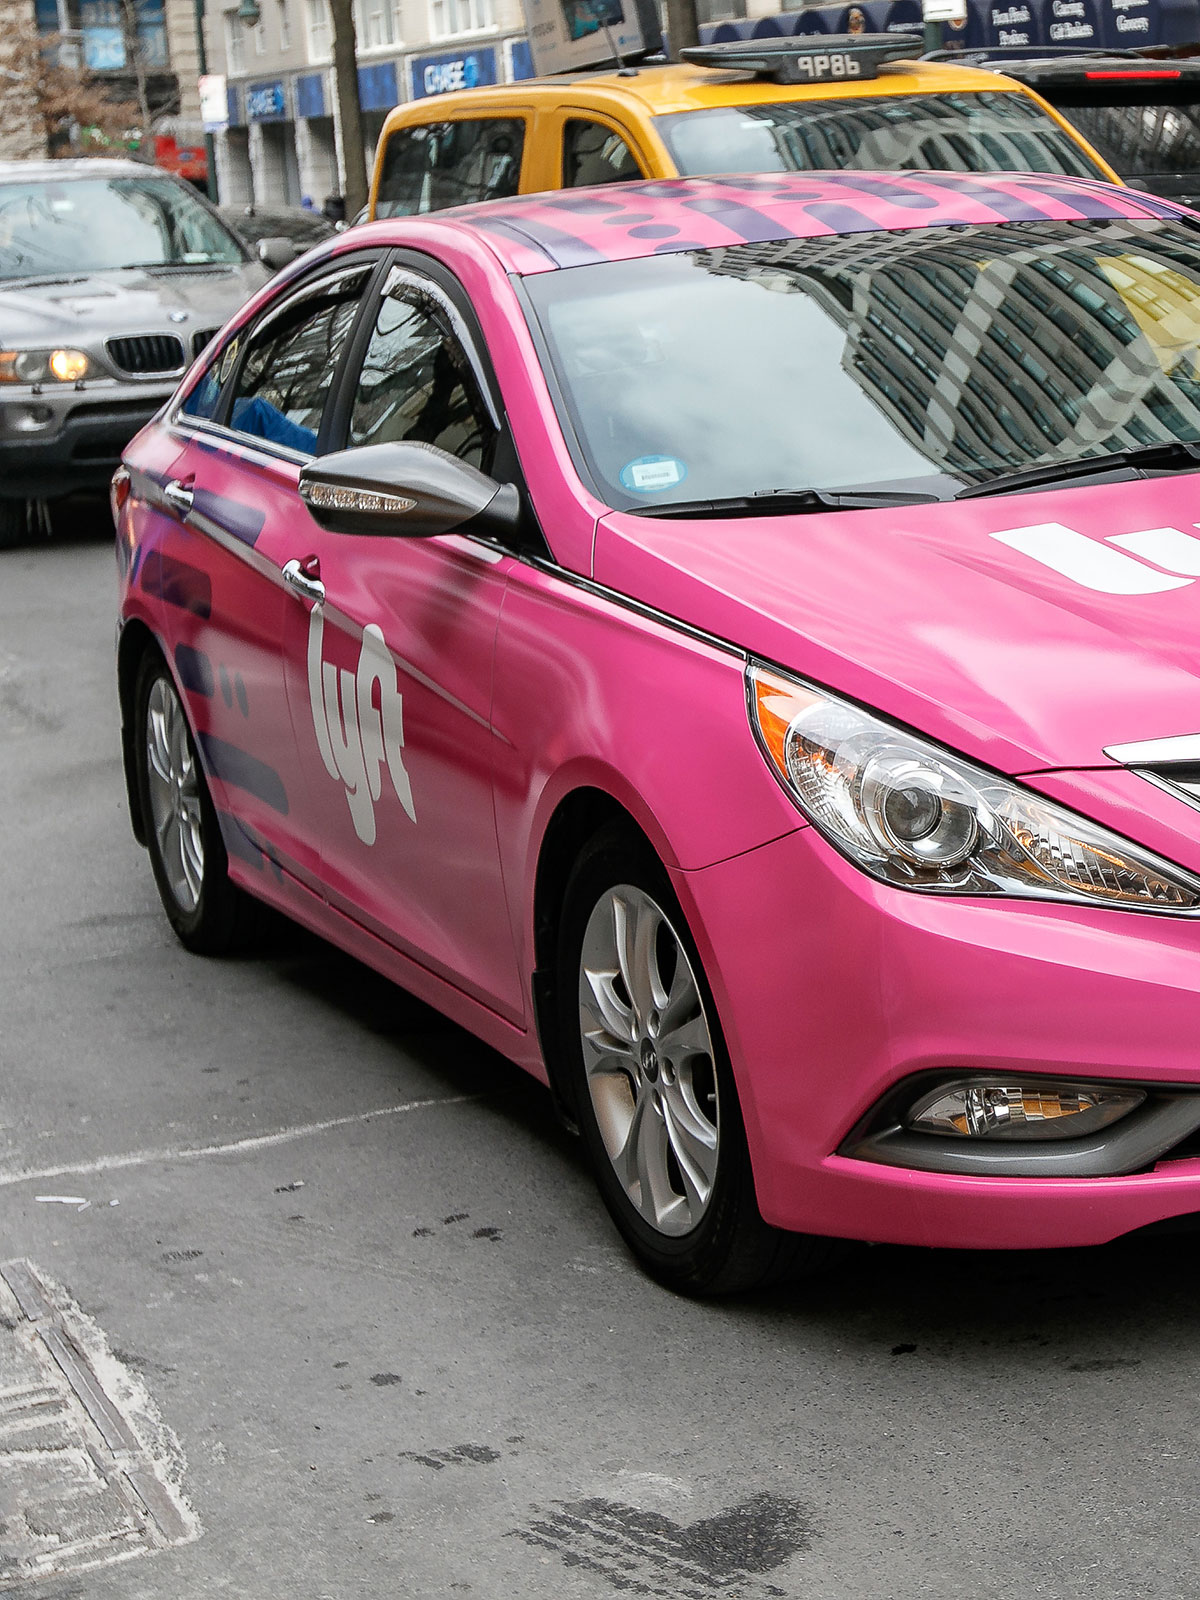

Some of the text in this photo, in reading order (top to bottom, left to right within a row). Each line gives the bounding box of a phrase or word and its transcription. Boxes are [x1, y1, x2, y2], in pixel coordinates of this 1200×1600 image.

[424, 60, 467, 94] CHASE
[798, 54, 860, 77] 9P86
[307, 601, 417, 847] lyft
